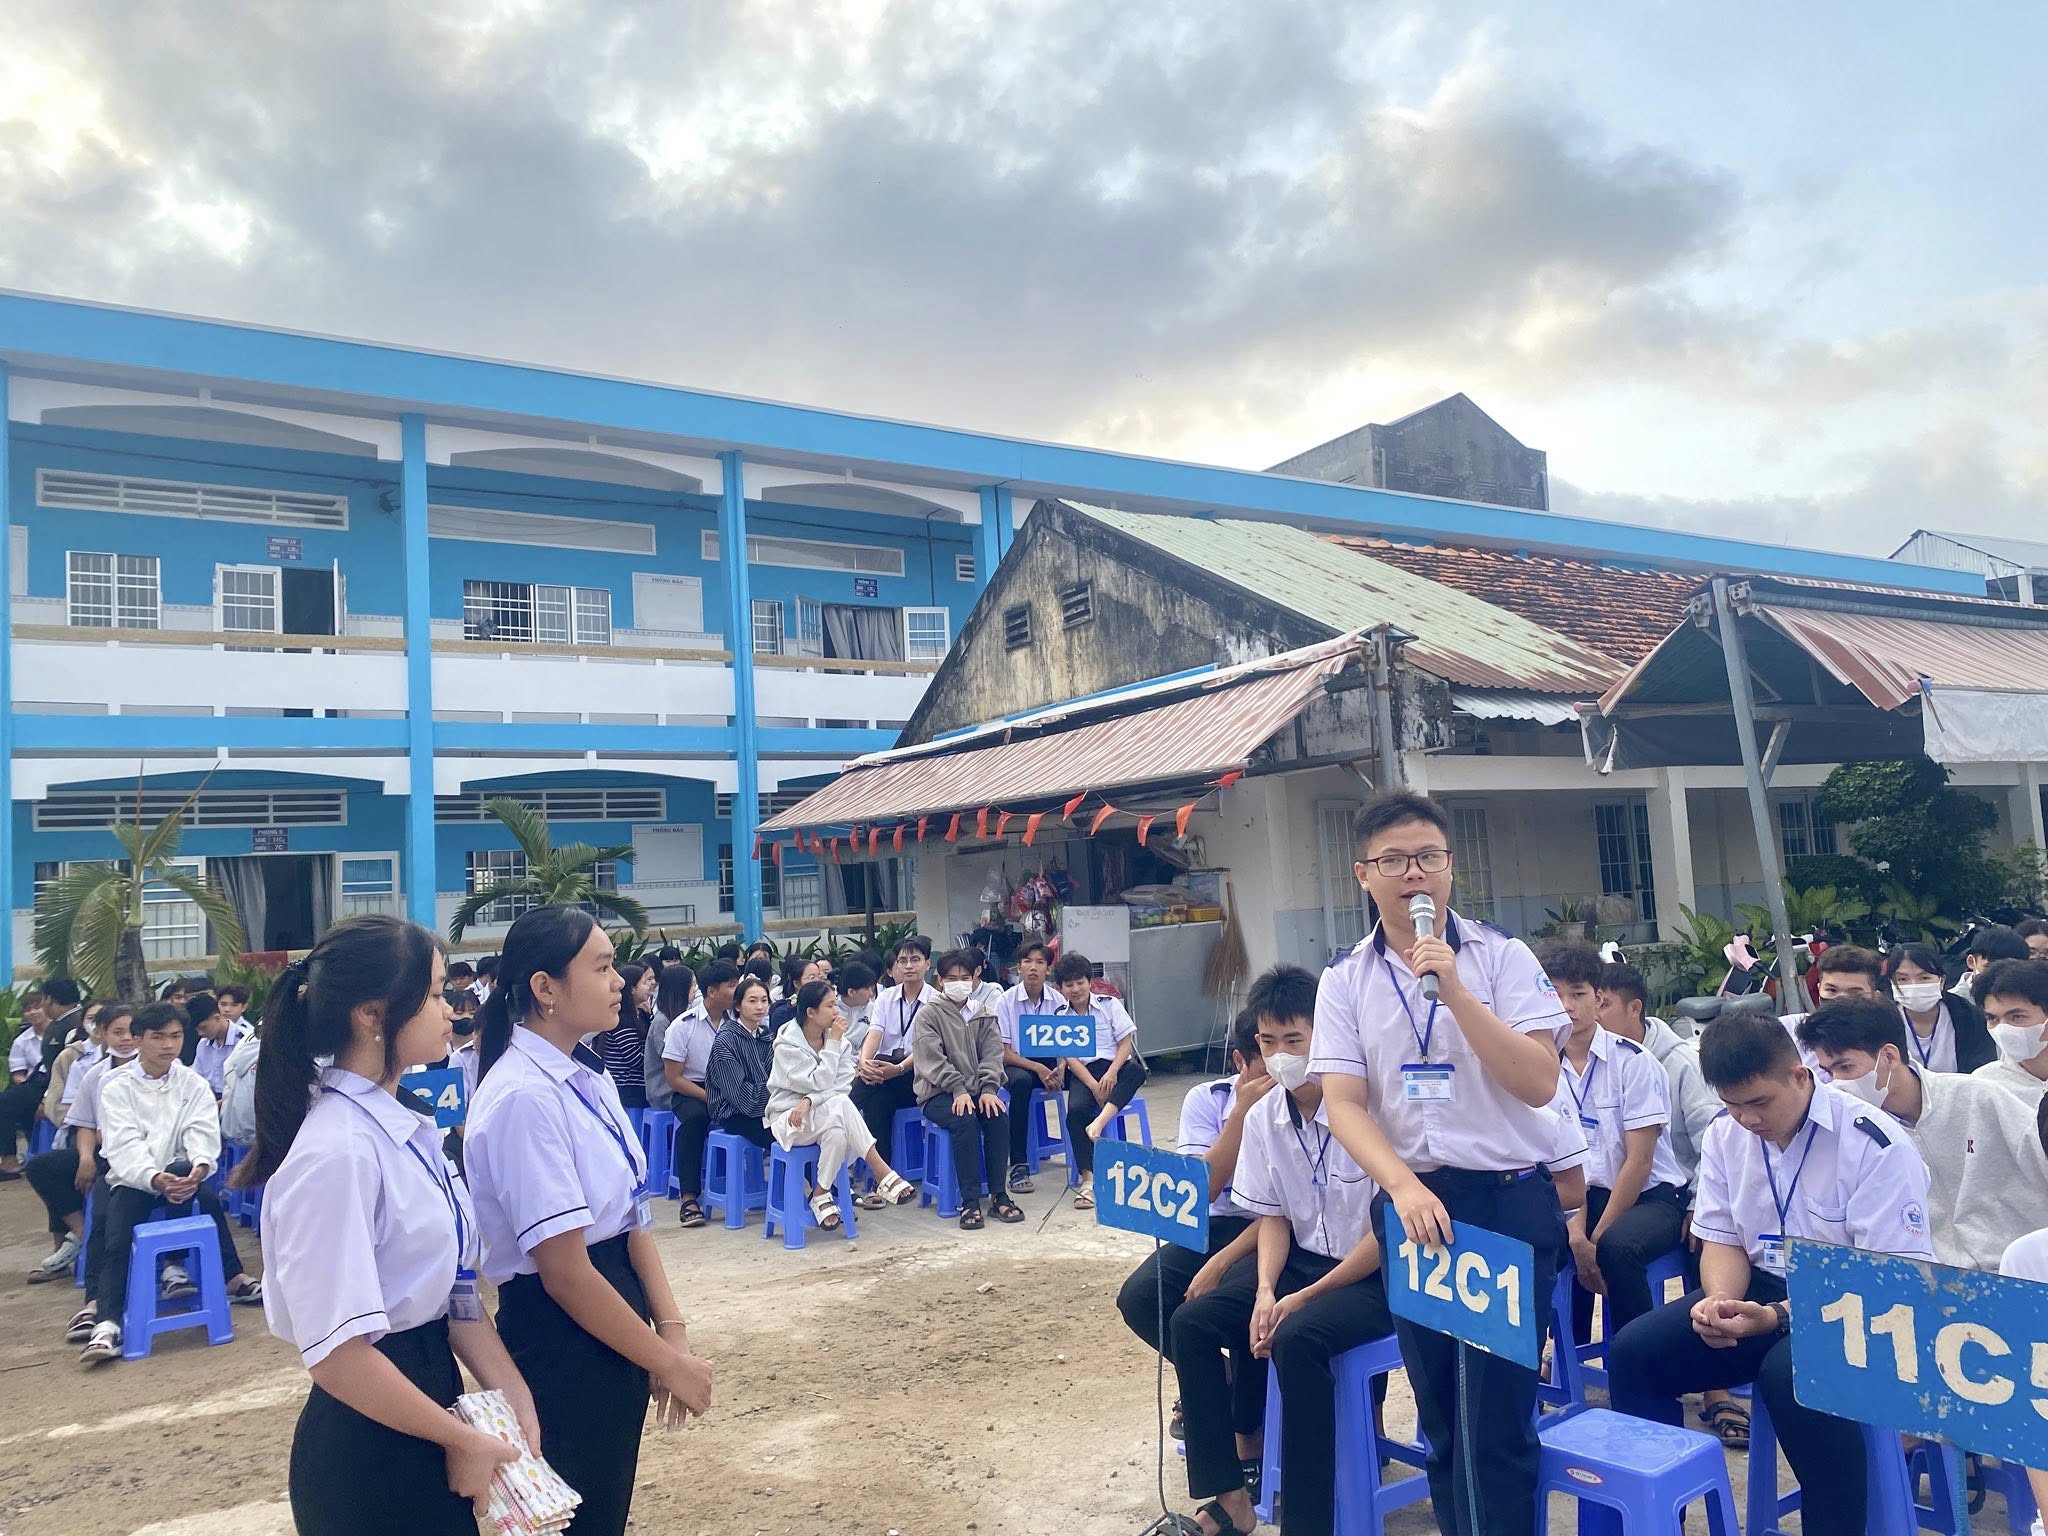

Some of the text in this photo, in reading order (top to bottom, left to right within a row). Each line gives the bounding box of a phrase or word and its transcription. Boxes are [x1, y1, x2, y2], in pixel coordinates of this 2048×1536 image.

[1025, 1024, 1090, 1047] 12C3
[1107, 1160, 1199, 1229] 12C2
[1398, 1238, 1521, 1328] 12C1
[1820, 1292, 2048, 1422] 11C
